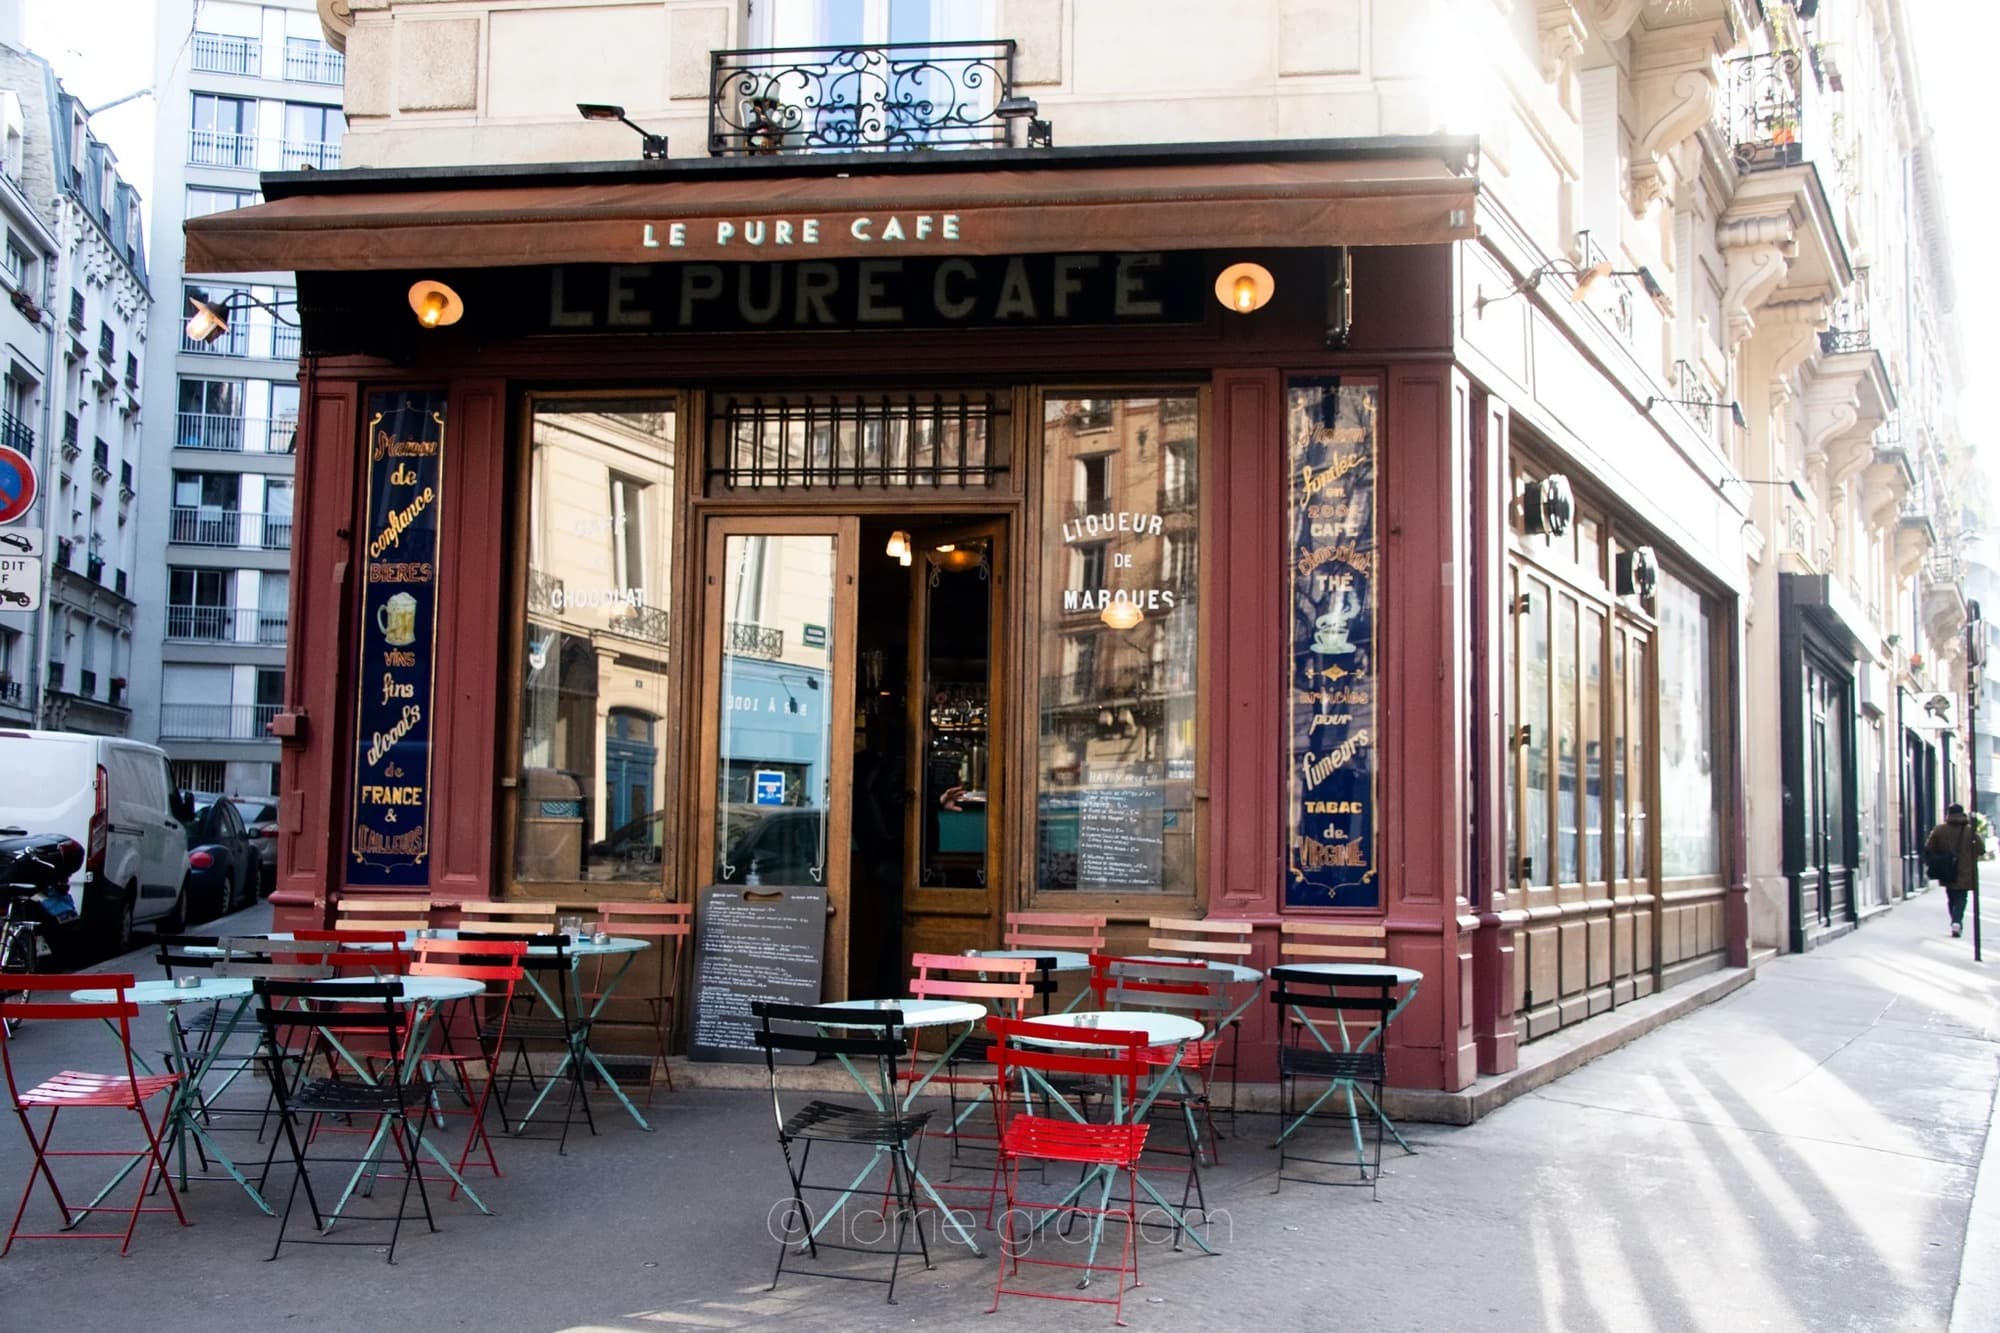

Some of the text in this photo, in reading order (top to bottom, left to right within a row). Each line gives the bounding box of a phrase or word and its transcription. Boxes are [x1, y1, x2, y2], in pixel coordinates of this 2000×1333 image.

[643, 214, 961, 247] LE PURE CAFE
[549, 264, 652, 327] LE
[678, 259, 904, 326] PURE
[390, 462, 417, 486] de
[370, 487, 436, 558] confiance
[1063, 512, 1163, 543] LIQUEUR
[1113, 553, 1133, 568] DE
[1315, 572, 1354, 592] THÉ
[551, 587, 645, 609] CHOCOLAT
[1064, 589, 1175, 610] MARQUES
[381, 672, 415, 706] fins
[367, 704, 422, 766] alcools
[1308, 713, 1353, 735] pour
[384, 761, 405, 777] de
[1302, 729, 1369, 791] fumeurs
[361, 785, 423, 806] FRANCE
[384, 807, 397, 823] &
[1304, 801, 1363, 814] TABAC
[1323, 822, 1349, 839] de
